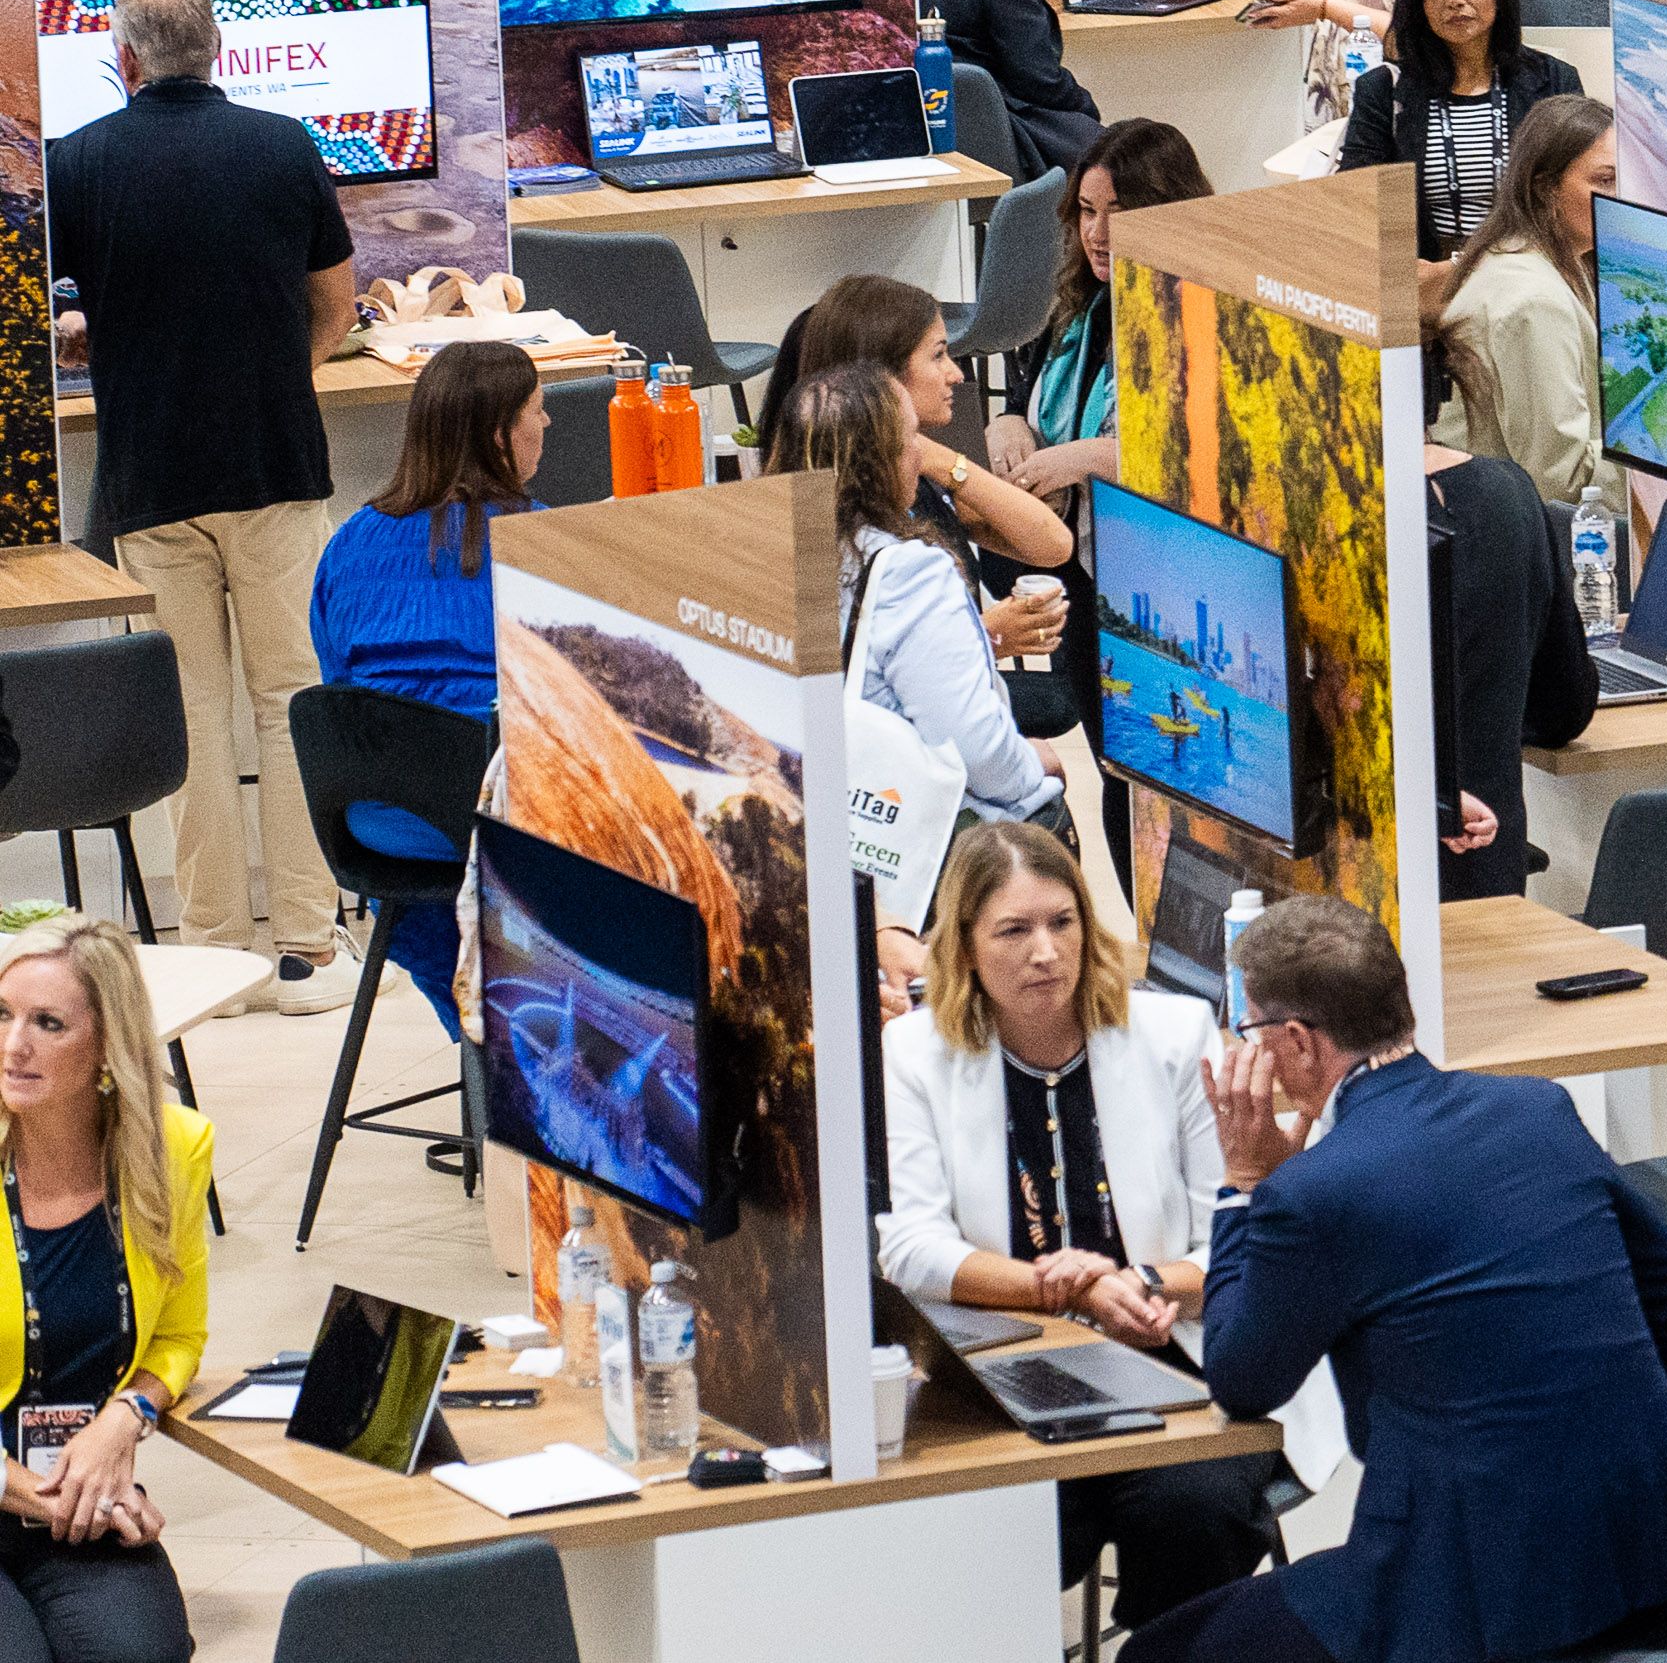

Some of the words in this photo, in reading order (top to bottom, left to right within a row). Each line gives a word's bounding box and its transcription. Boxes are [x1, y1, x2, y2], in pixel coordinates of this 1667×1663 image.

[218, 42, 328, 77] NIFEX
[267, 82, 288, 94] WA
[1256, 274, 1284, 305] PAN
[1285, 283, 1334, 322] PACIFIC
[1335, 301, 1378, 337] PERTH
[677, 596, 729, 638] OPTUS
[727, 615, 796, 665] STADIUM
[848, 789, 900, 825] iTag
[865, 861, 898, 881] Events
